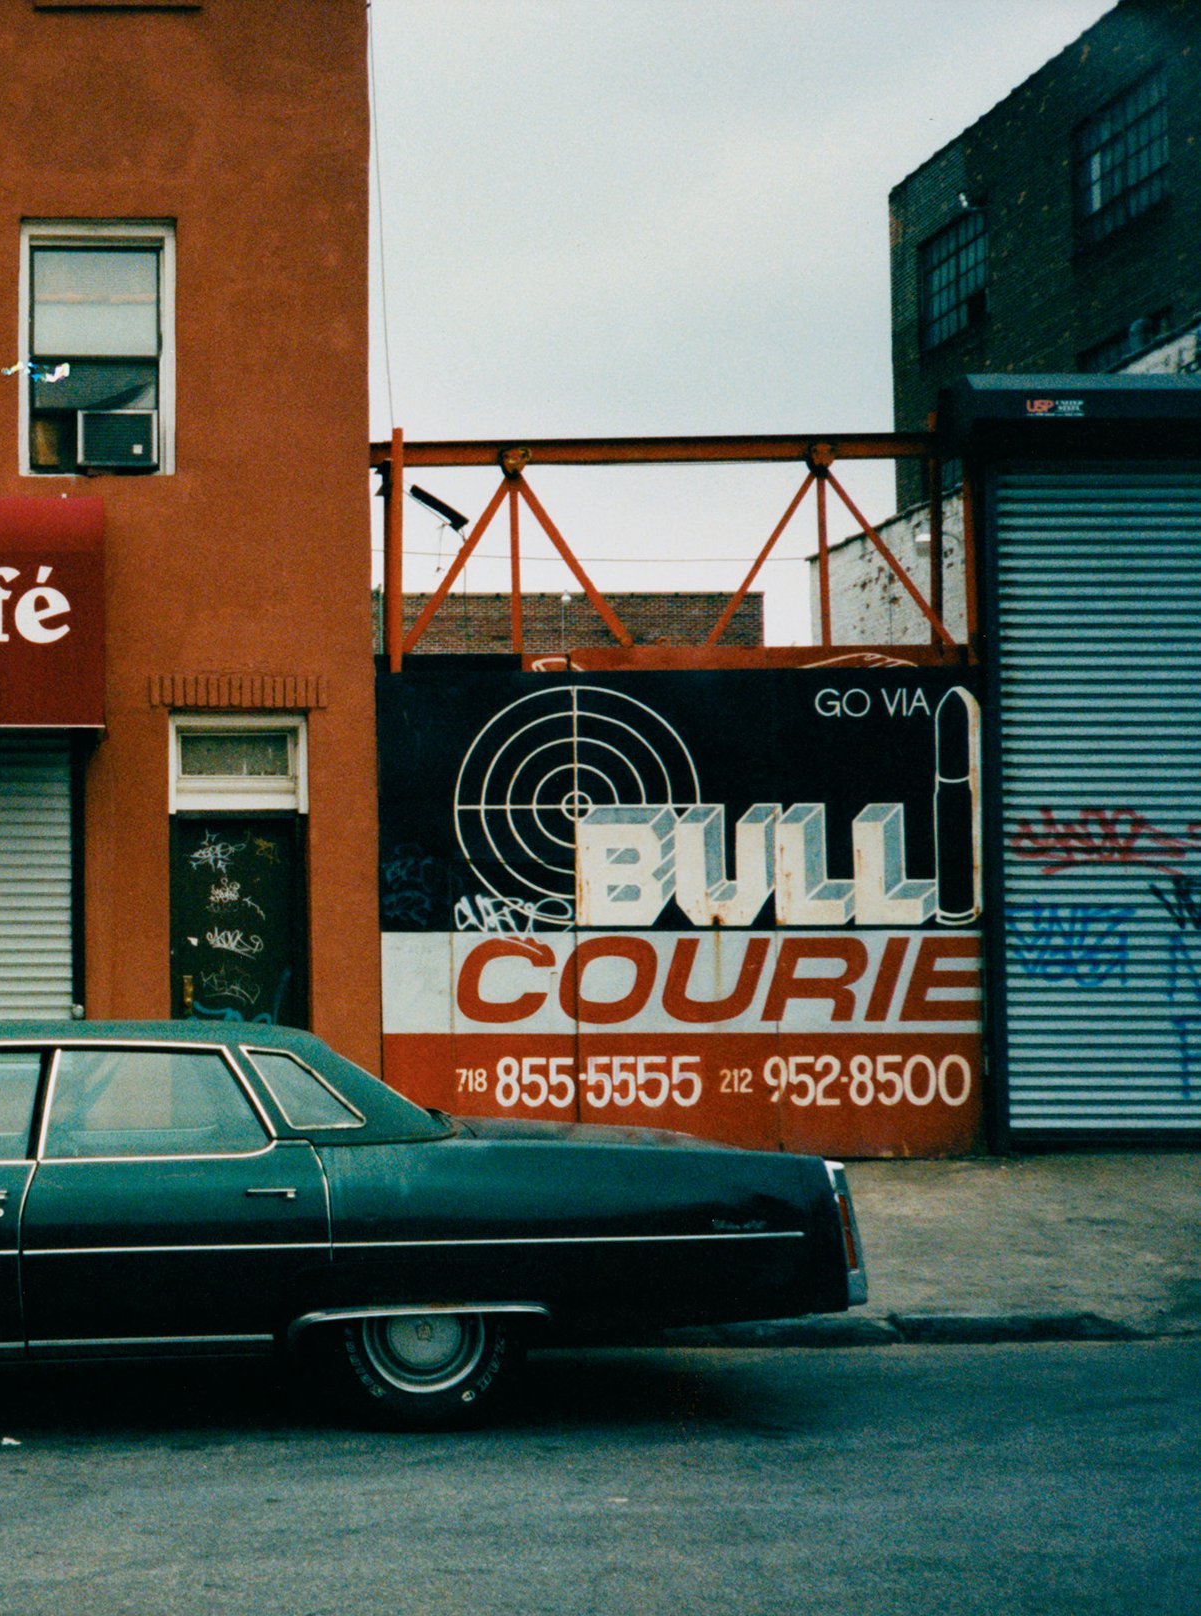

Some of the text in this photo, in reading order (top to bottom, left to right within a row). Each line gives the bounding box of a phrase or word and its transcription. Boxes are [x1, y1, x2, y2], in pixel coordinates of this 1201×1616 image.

[815, 688, 930, 717] GO VIA
[576, 803, 937, 926] BULL
[455, 1054, 971, 1108] 718 855-5555 212 952-8500
